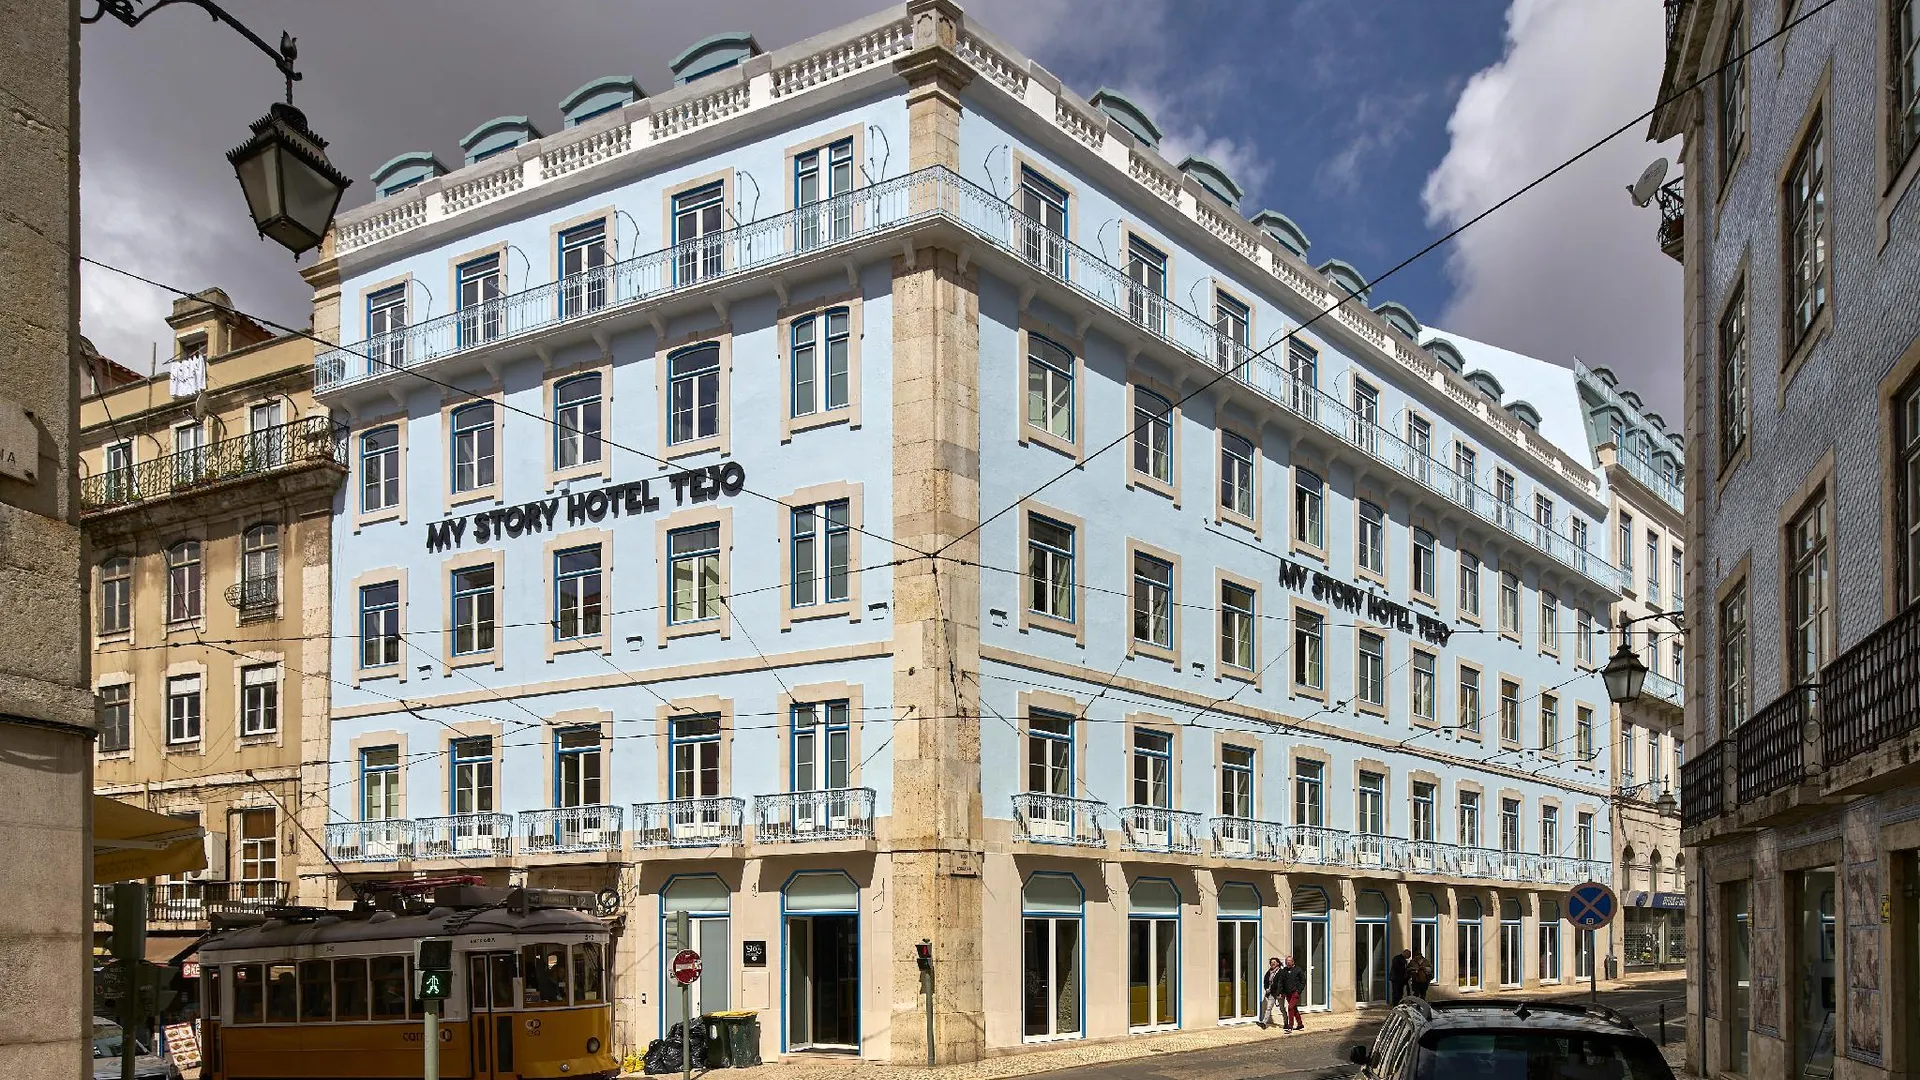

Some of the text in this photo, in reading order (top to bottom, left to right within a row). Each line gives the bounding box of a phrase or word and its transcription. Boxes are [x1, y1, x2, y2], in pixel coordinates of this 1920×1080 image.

[427, 461, 746, 553] MY STORY HOTEL TEJO
[1279, 559, 1452, 648] MY STORY HOTEL TEJO
